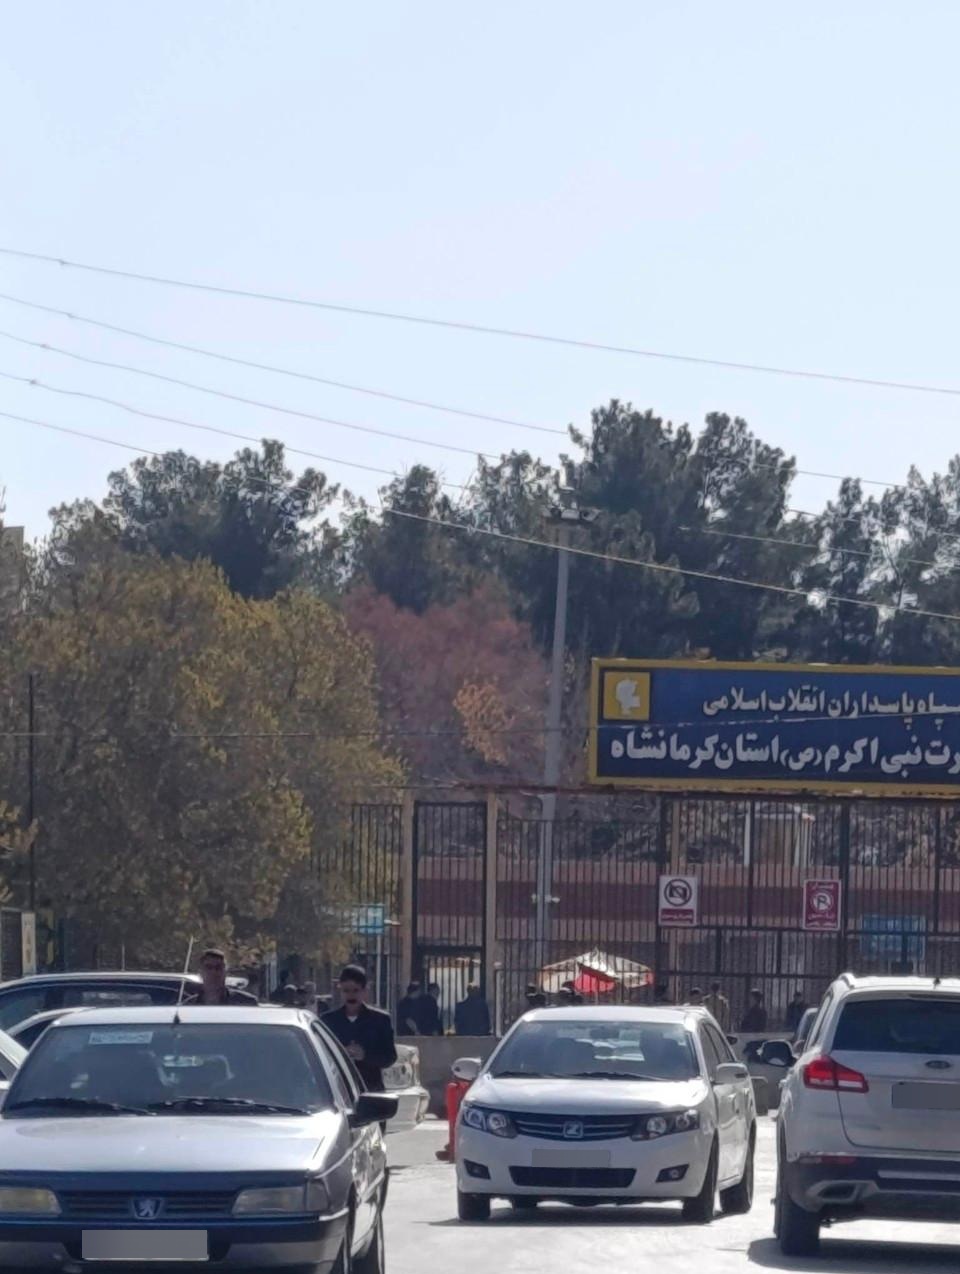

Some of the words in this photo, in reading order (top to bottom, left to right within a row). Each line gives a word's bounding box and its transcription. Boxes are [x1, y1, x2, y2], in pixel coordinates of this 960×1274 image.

[704, 686, 766, 716] اسلامی
[769, 685, 825, 722] انقلاب
[827, 690, 913, 730] پاسداران
[611, 727, 719, 770] کرمانشاه
[715, 733, 779, 770] استان
[824, 738, 879, 773] اکرم
[881, 736, 922, 778] نبی
